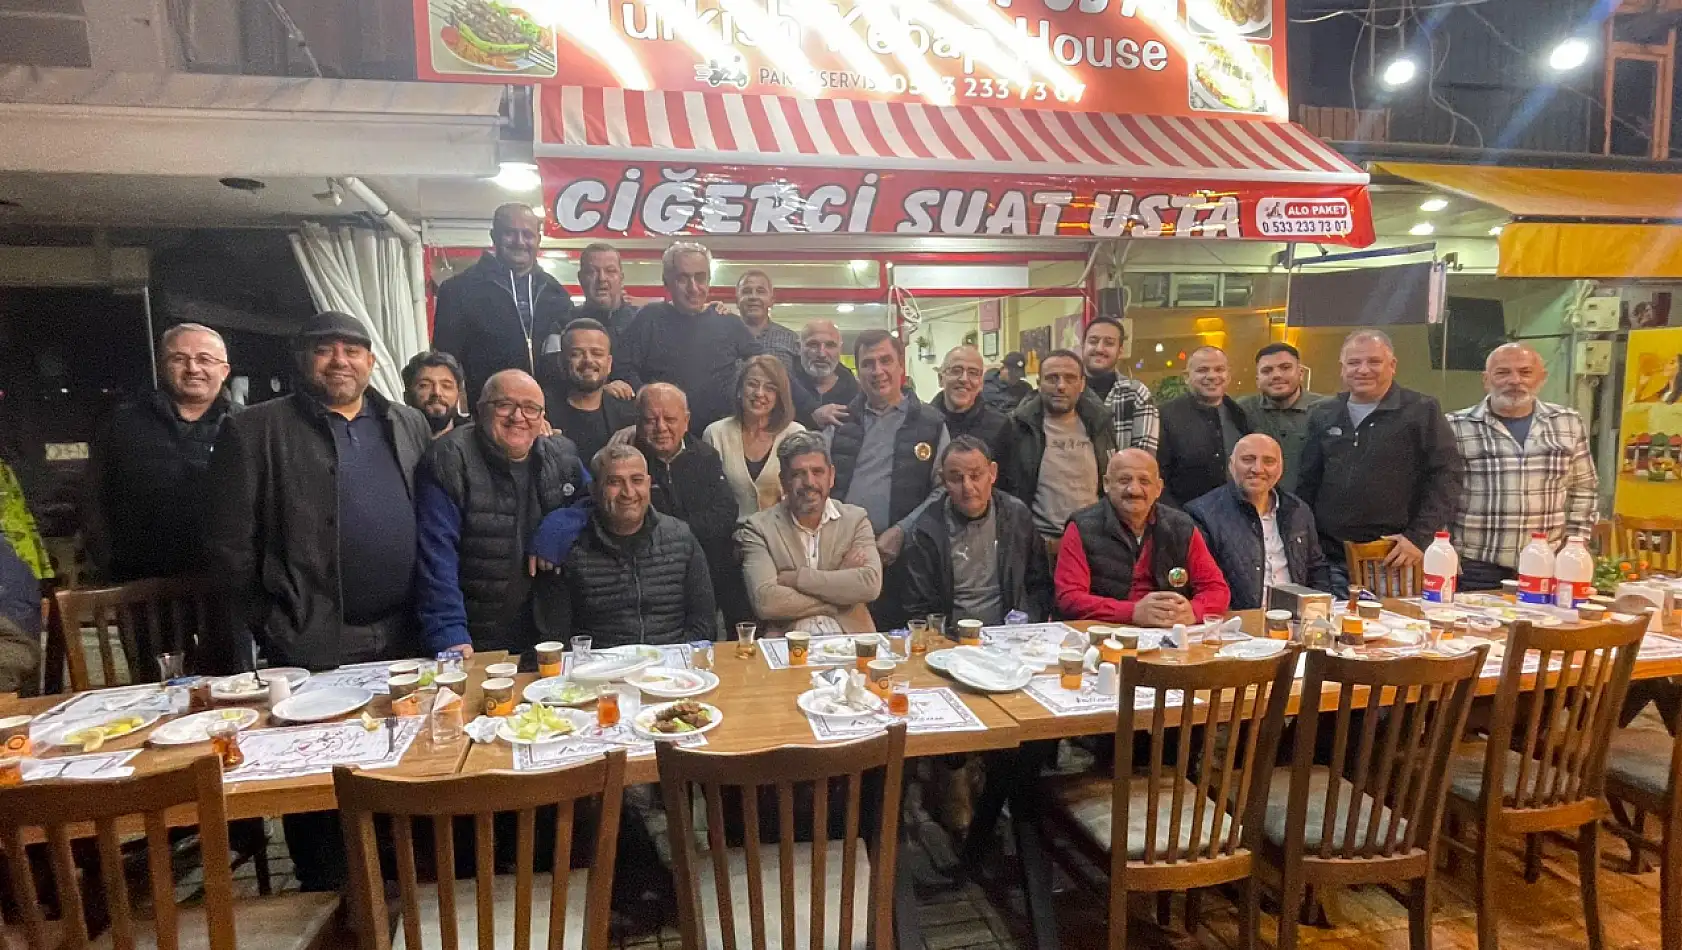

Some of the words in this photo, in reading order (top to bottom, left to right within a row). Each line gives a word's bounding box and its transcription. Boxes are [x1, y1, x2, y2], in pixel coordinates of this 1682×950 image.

[1014, 16, 1168, 71] House
[758, 68, 817, 87] PAK
[964, 78, 1010, 99] 233
[555, 167, 878, 233] CİĞERCİ
[895, 188, 1076, 235] SUAT
[1088, 190, 1244, 238] USTA
[1288, 205, 1310, 216] ALO
[1312, 205, 1346, 216] PAKET
[1262, 221, 1269, 233] 0
[1273, 221, 1293, 233] 533
[1296, 221, 1316, 233] 233
[1319, 220, 1332, 232] 73
[1335, 220, 1347, 232] 07
